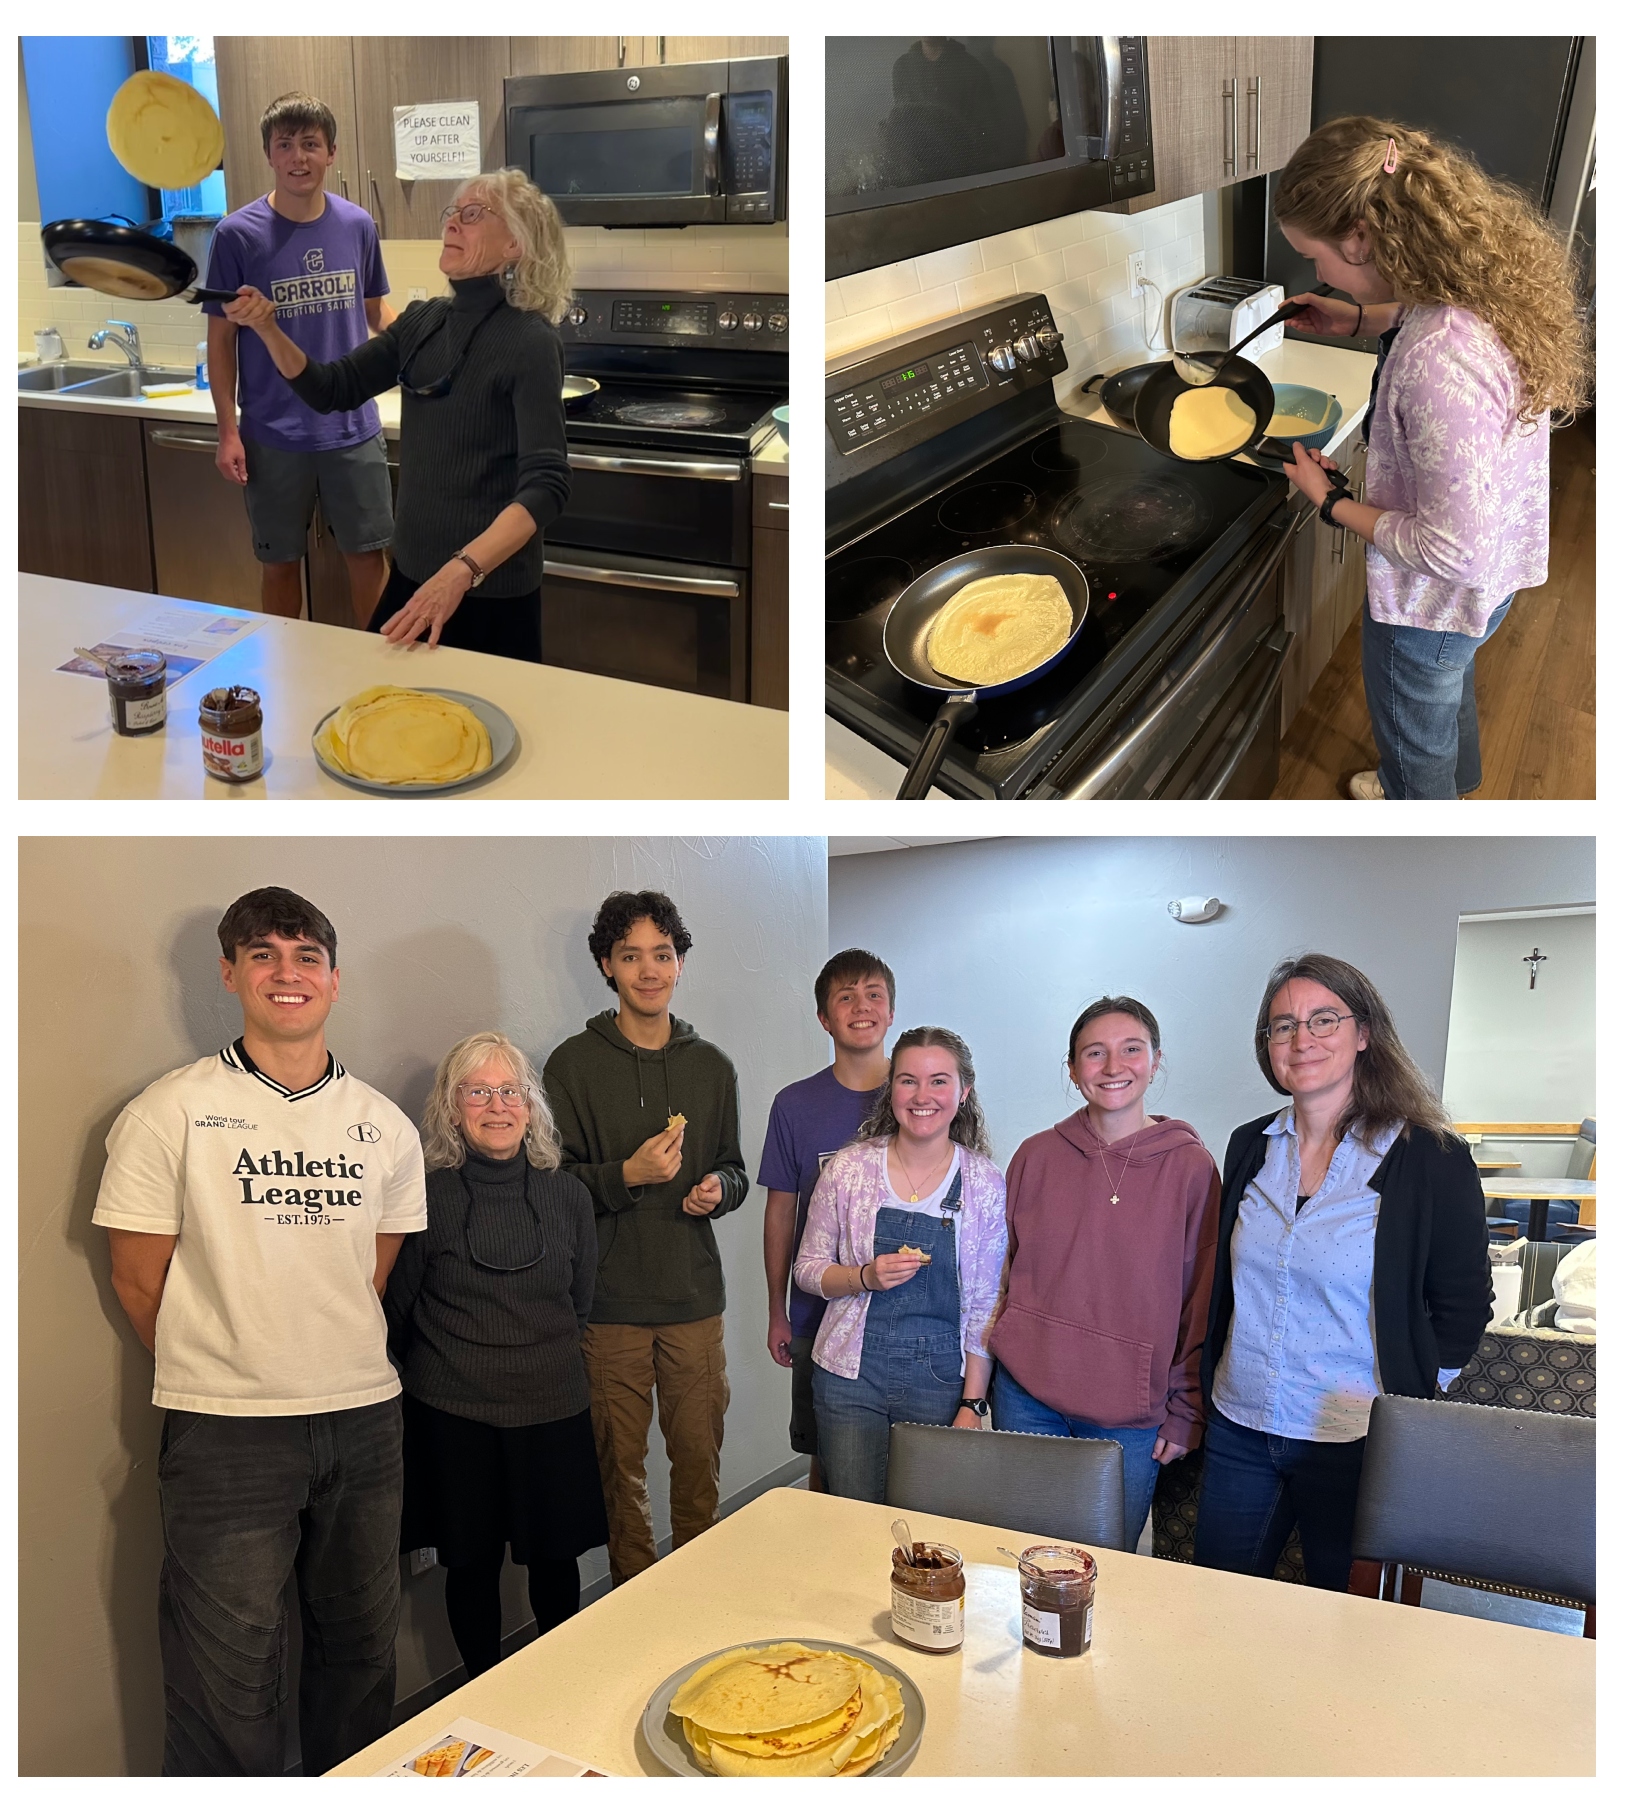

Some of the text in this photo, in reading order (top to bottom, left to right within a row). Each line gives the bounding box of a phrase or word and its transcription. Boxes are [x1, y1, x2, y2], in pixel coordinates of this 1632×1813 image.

[403, 115, 470, 128] PLEASE CLEAN
[414, 134, 460, 145] UP AFTER
[410, 151, 465, 163] YOURSELF!!
[274, 276, 355, 303] CARROLL
[276, 300, 356, 319] FIGHTING SAINTS
[195, 1120, 225, 1128] GRAND
[205, 1114, 228, 1123] World
[232, 1148, 364, 1179] Athletic
[238, 1178, 362, 1214] League
